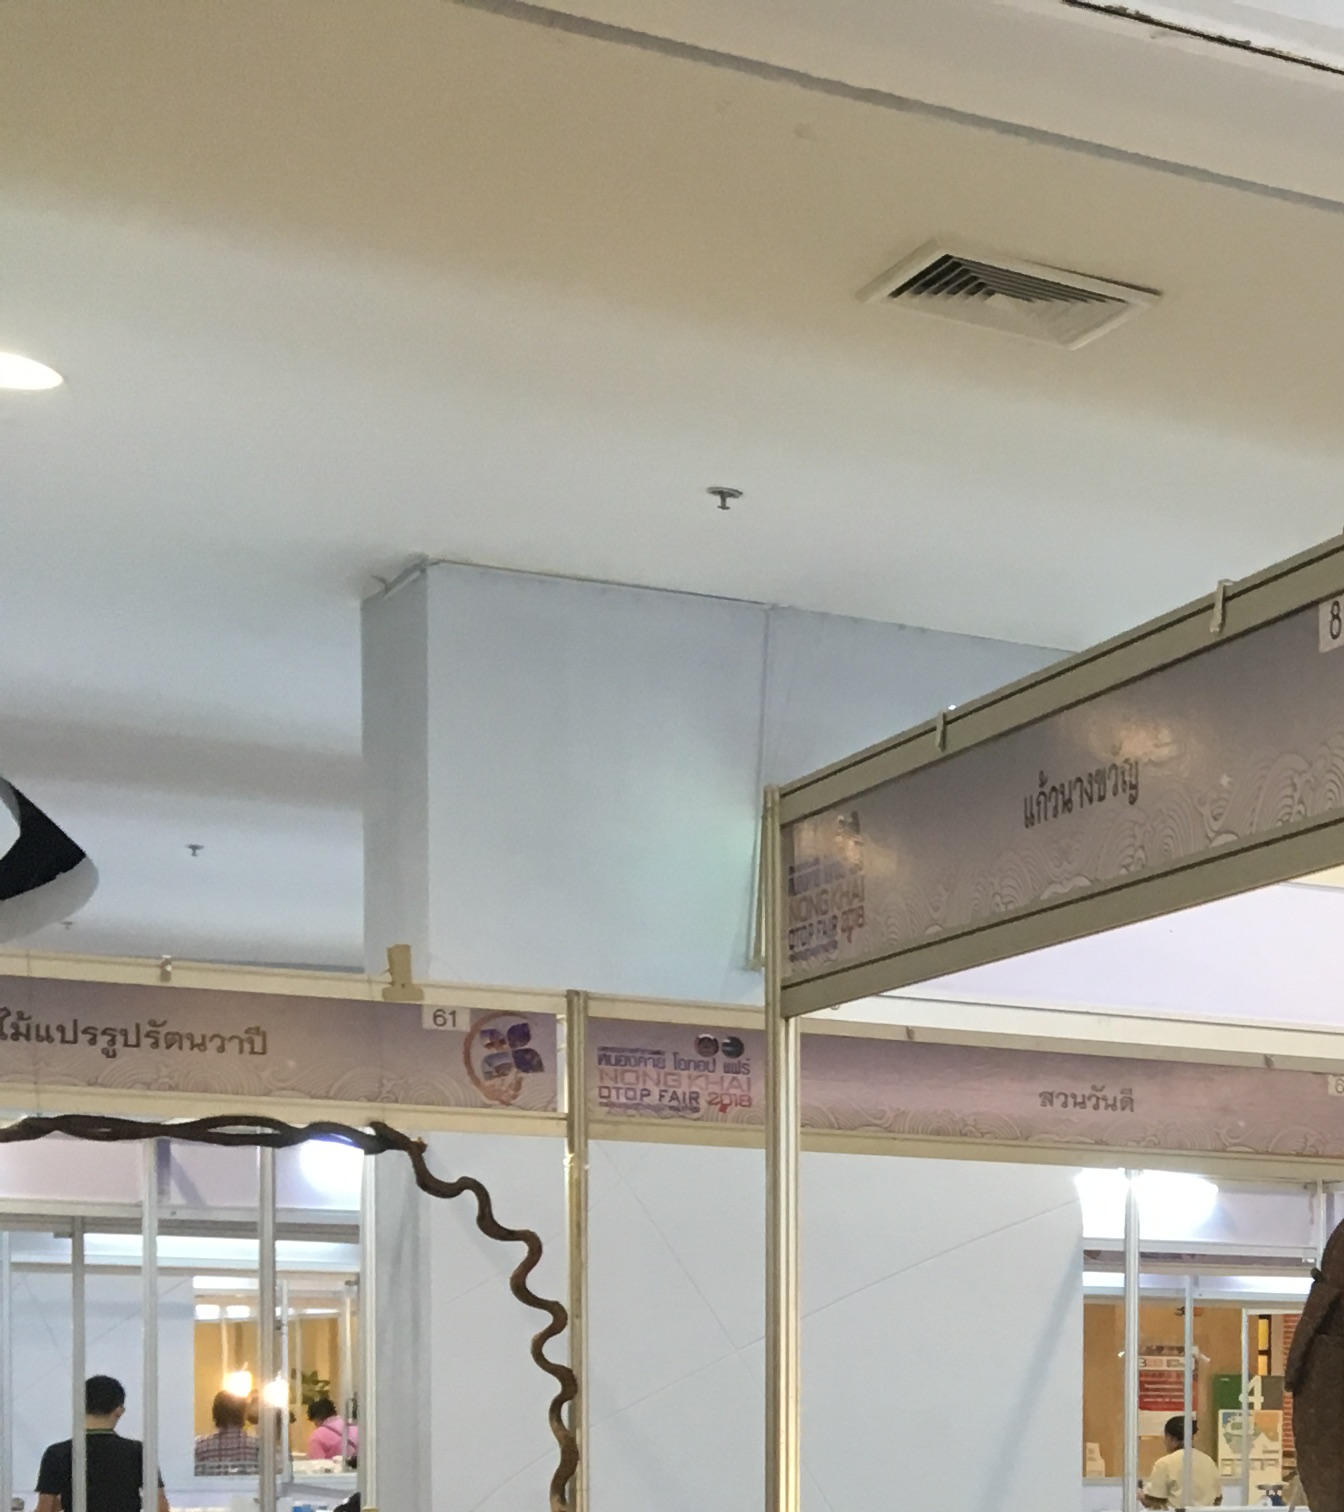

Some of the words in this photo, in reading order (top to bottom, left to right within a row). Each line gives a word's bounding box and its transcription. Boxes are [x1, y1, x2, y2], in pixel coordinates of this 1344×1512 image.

[431, 1009, 458, 1027] 61
[672, 1052, 716, 1072] โอทอป
[723, 1058, 751, 1075] แฟร์
[599, 1069, 682, 1089] NONG
[688, 1073, 752, 1093] KHAI
[598, 1086, 651, 1101] OTOP
[658, 1090, 700, 1105] FAIR
[707, 1093, 752, 1108] 2018
[1038, 1085, 1134, 1113] สวนวันดี
